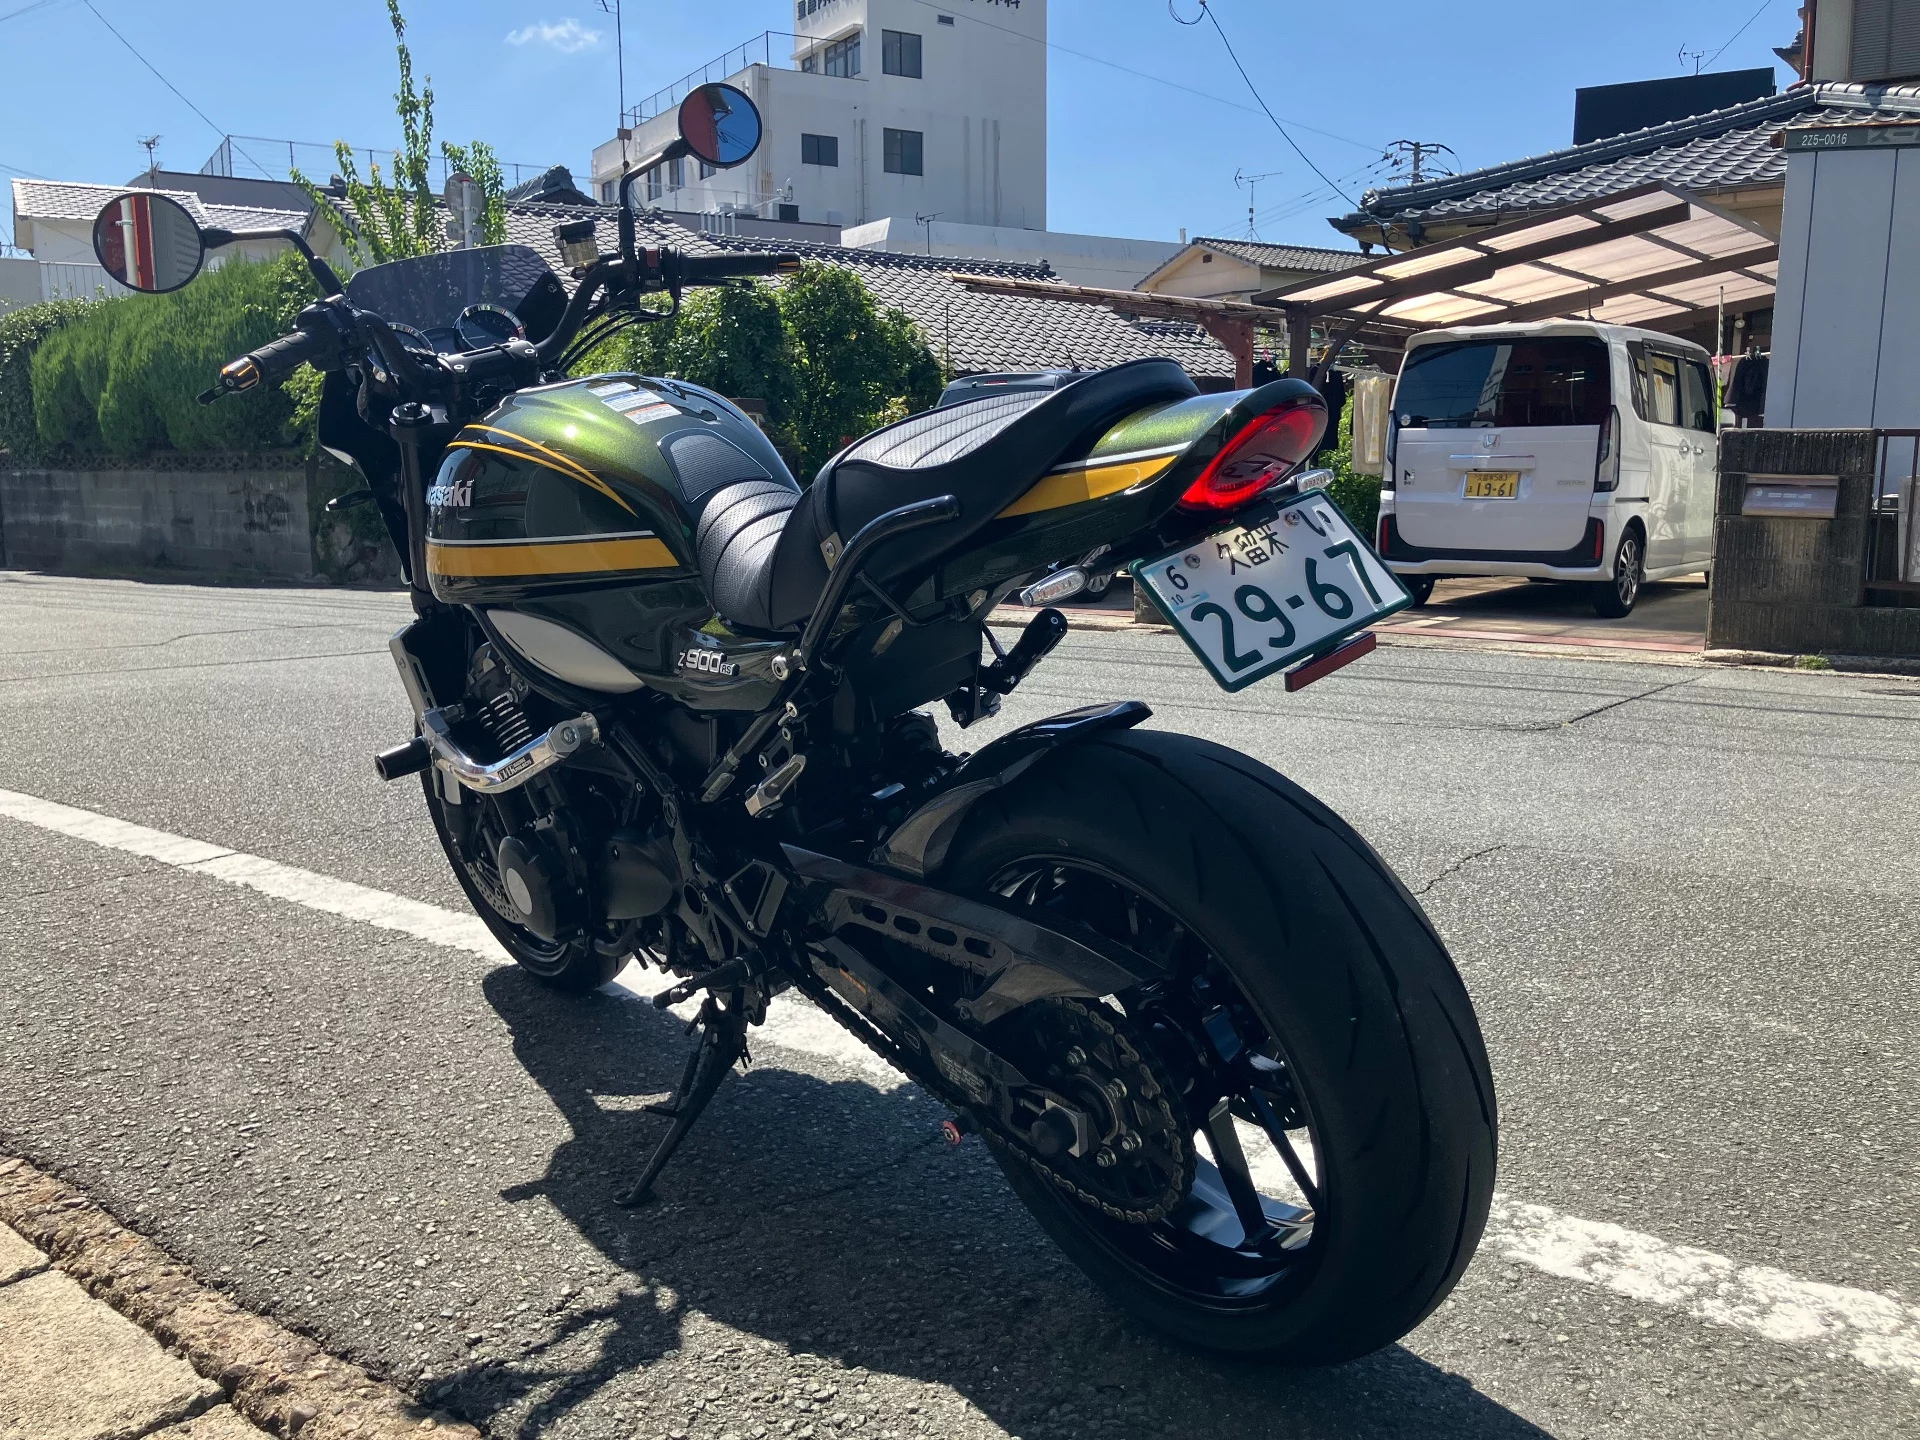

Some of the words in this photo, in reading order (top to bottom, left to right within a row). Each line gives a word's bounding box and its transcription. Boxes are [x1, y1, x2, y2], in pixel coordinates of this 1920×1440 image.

[1476, 482, 1514, 497] 19-61
[1216, 523, 1290, 576] 久留米
[1165, 564, 1189, 591] 6
[1171, 594, 1184, 606] 10
[1190, 539, 1383, 673] 29-67
